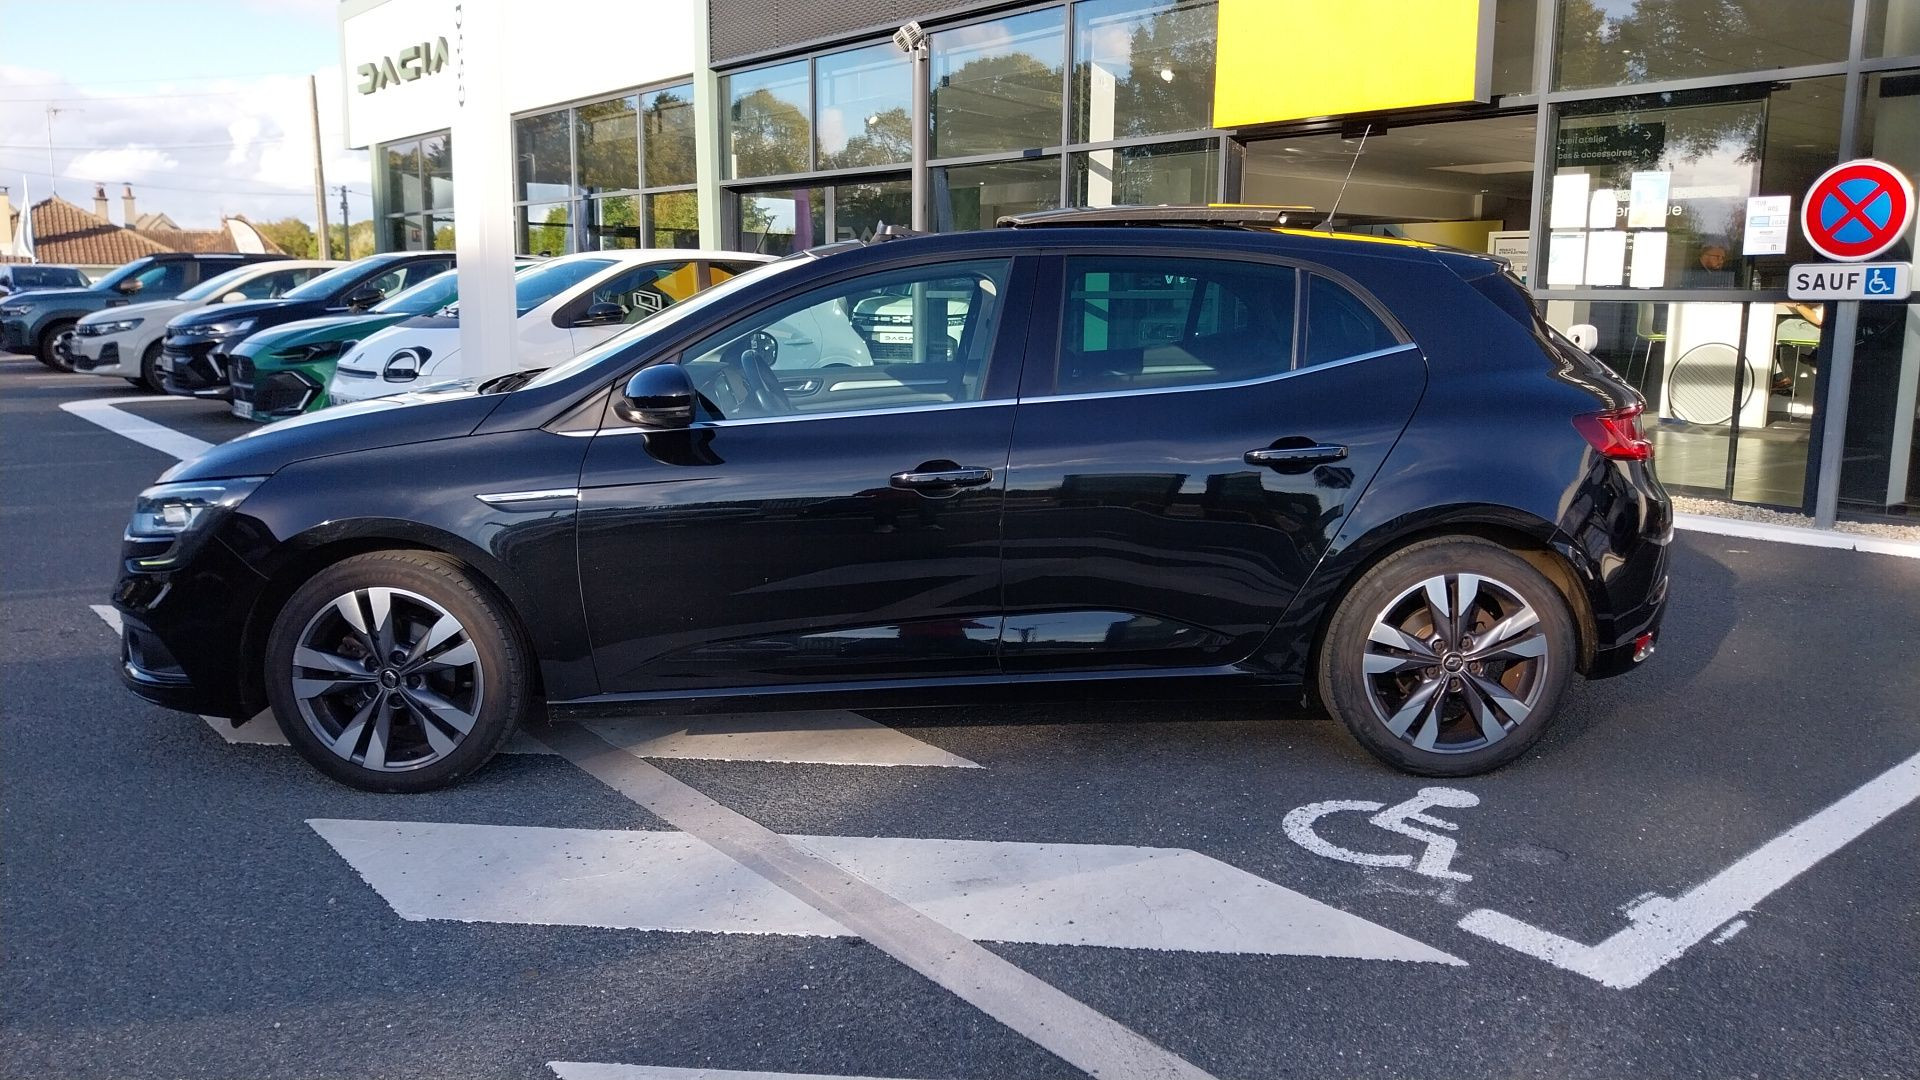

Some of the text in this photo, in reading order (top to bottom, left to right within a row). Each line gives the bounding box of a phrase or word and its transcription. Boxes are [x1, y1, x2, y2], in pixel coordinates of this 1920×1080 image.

[357, 36, 449, 95] DACIA
[1579, 135, 1608, 144] atelier
[1581, 149, 1633, 159] accessoires
[1796, 273, 1860, 291] SAUF
